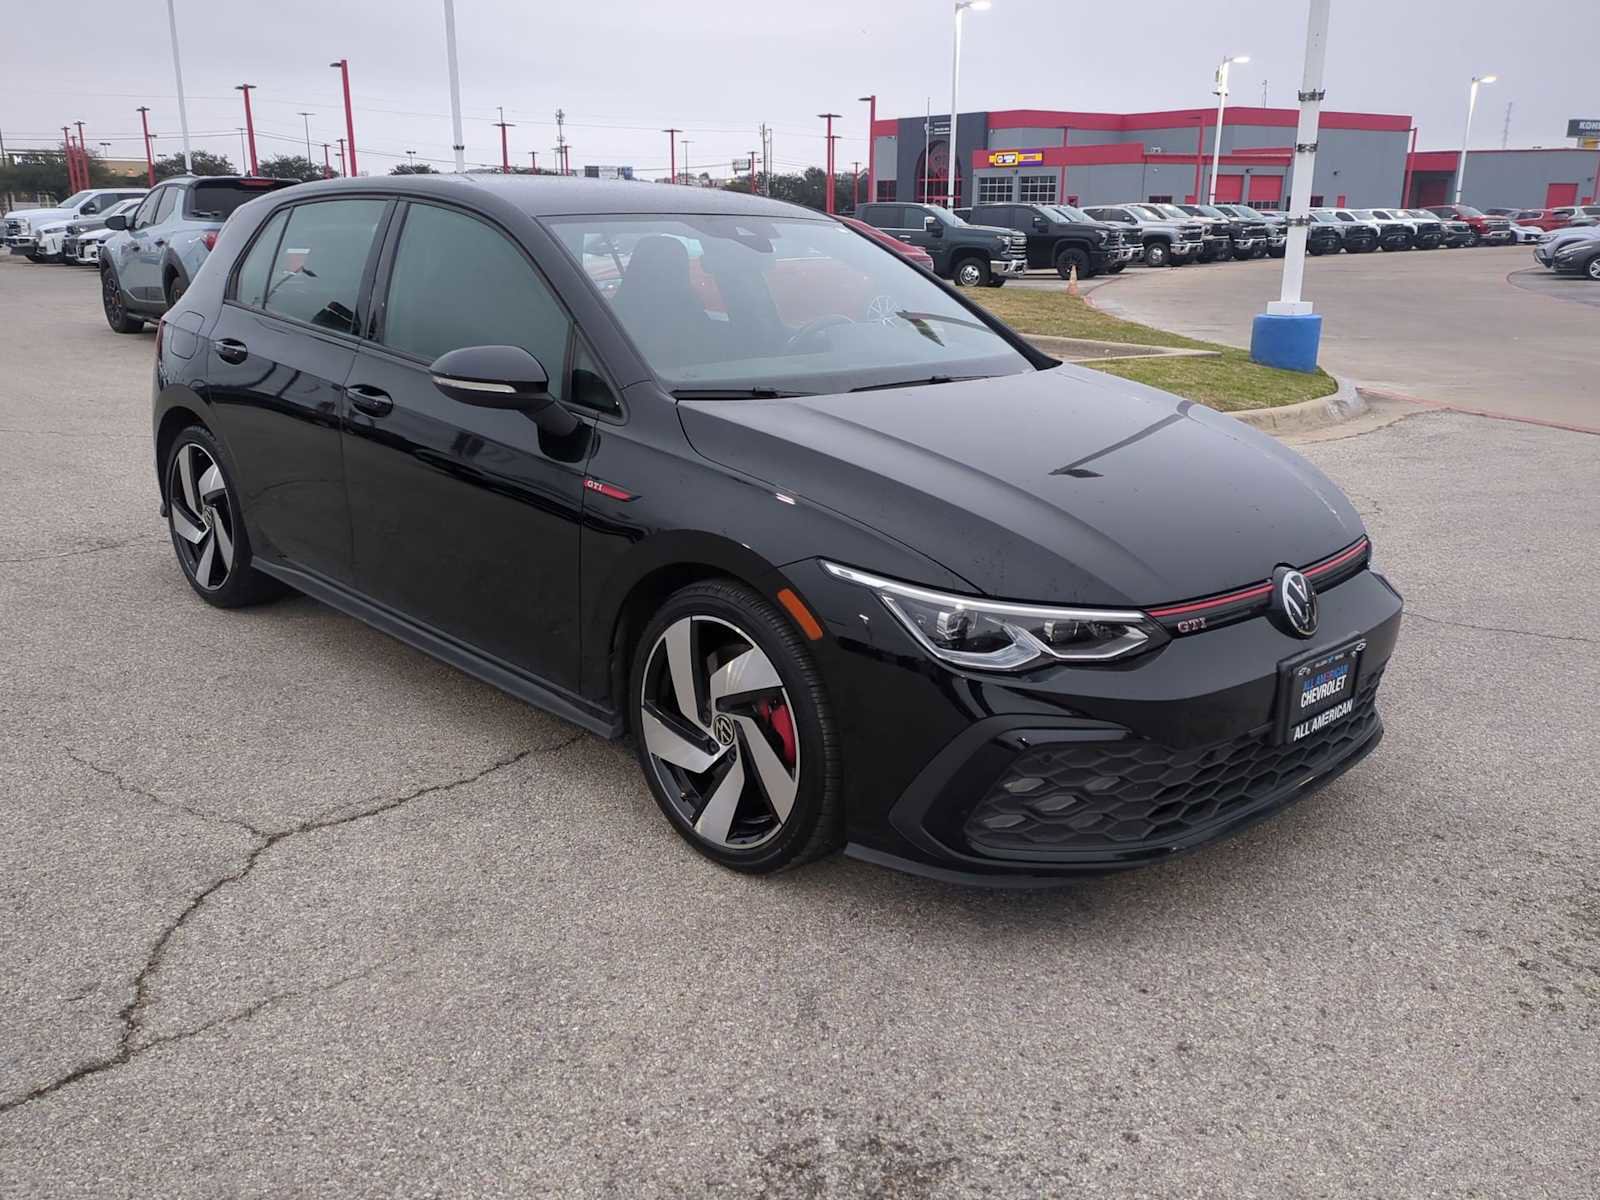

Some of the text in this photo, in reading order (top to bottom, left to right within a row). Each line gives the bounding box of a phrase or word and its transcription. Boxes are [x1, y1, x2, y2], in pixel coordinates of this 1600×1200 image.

[587, 480, 603, 491] GTI
[1178, 617, 1207, 633] GTI
[1300, 674, 1347, 708] CHEVROLET
[1293, 698, 1354, 742] ALL AMERICAN
